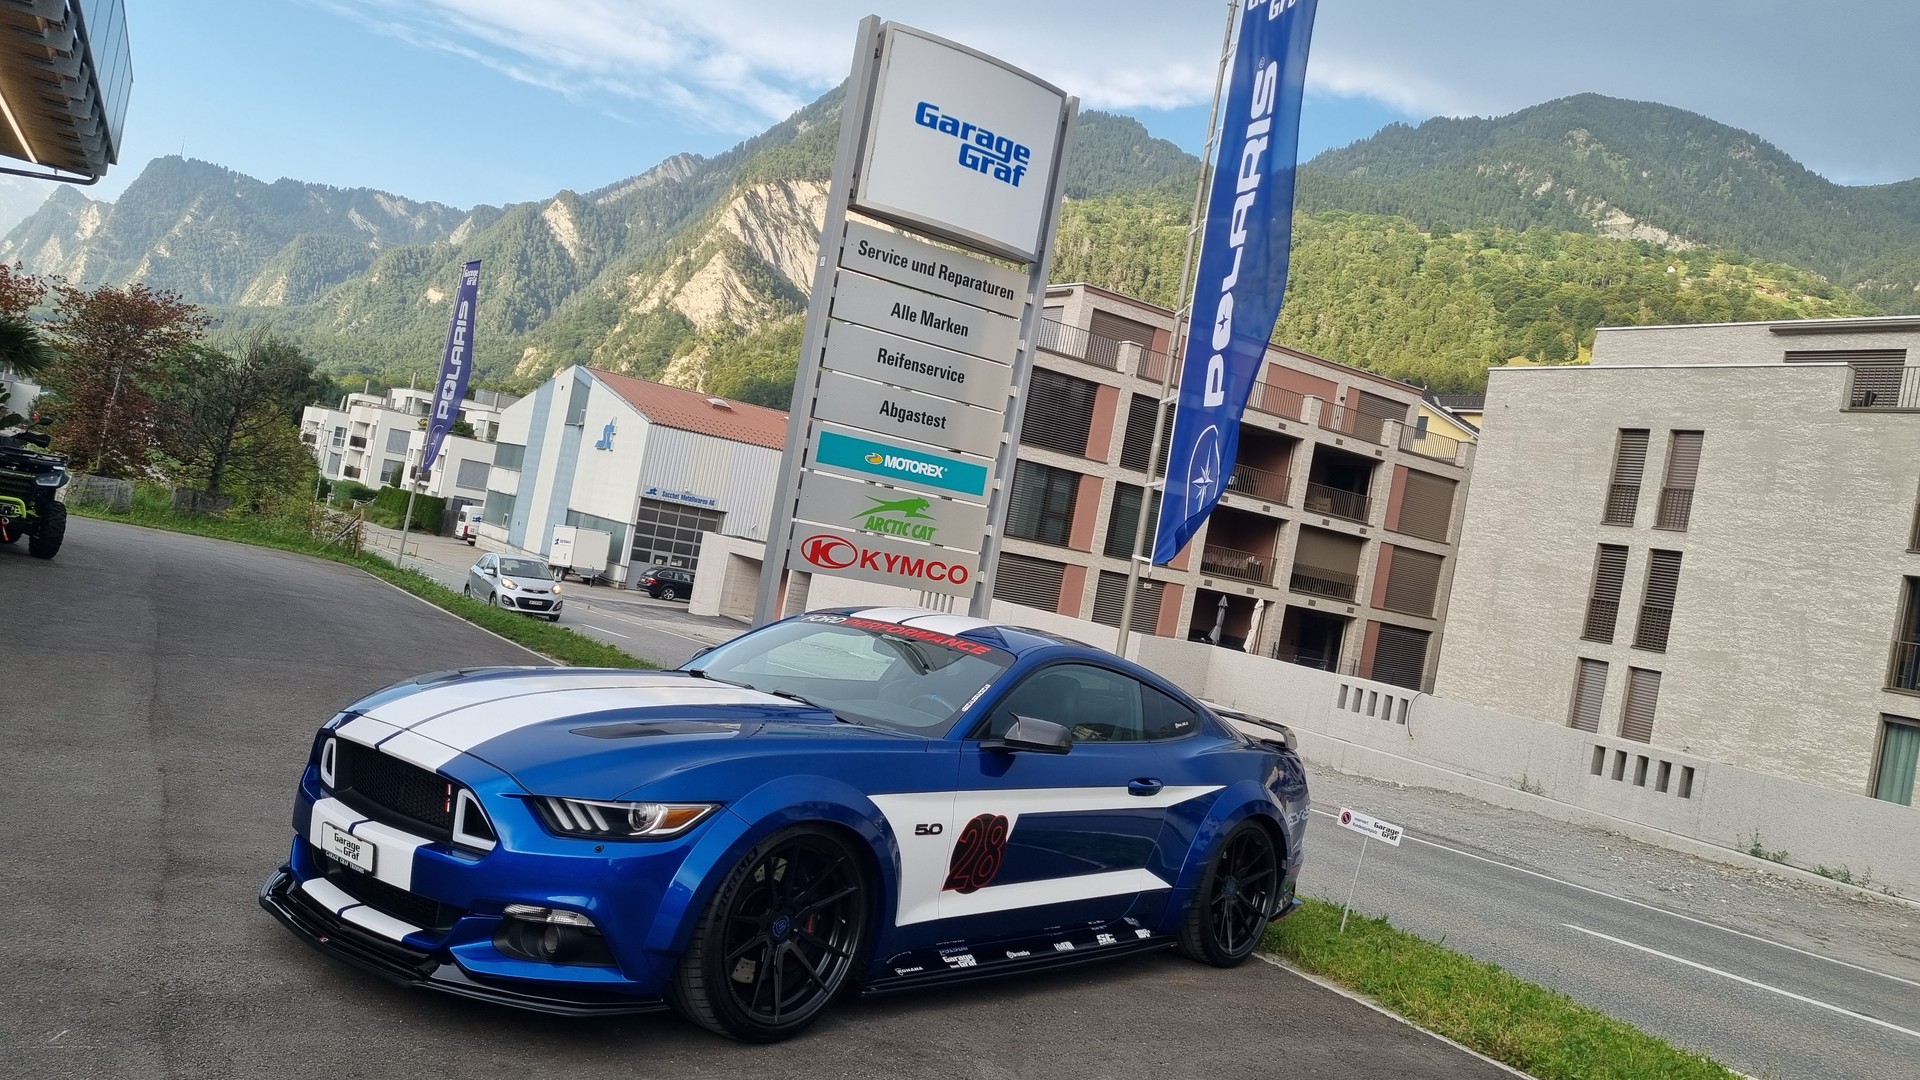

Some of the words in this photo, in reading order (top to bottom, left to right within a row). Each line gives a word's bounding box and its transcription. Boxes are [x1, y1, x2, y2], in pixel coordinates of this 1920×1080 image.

[915, 101, 1031, 165] Garage
[958, 143, 1027, 188] Graf
[1203, 61, 1278, 407] POLARIS
[858, 239, 908, 268] Service
[911, 260, 936, 277] und
[938, 264, 1015, 301] Reparaturen
[890, 302, 917, 323] Alle
[920, 310, 969, 337] Marken
[436, 300, 469, 420] POLARIS
[876, 347, 965, 384] Reifenservice
[879, 400, 947, 430] Abgastest
[884, 454, 944, 479] MOTOREX
[863, 515, 910, 538] ARCTIC
[911, 525, 937, 541] CAT
[859, 548, 969, 585] KYMCO
[801, 615, 848, 625] FORD
[844, 618, 992, 655] PERFORMANCE
[334, 832, 361, 852] Garage
[1373, 821, 1400, 836] Garage
[1381, 831, 1398, 842] Graf
[343, 846, 360, 861] Graf
[942, 813, 1009, 894] 28
[942, 954, 975, 964] Garage
[957, 959, 978, 968] Graf
